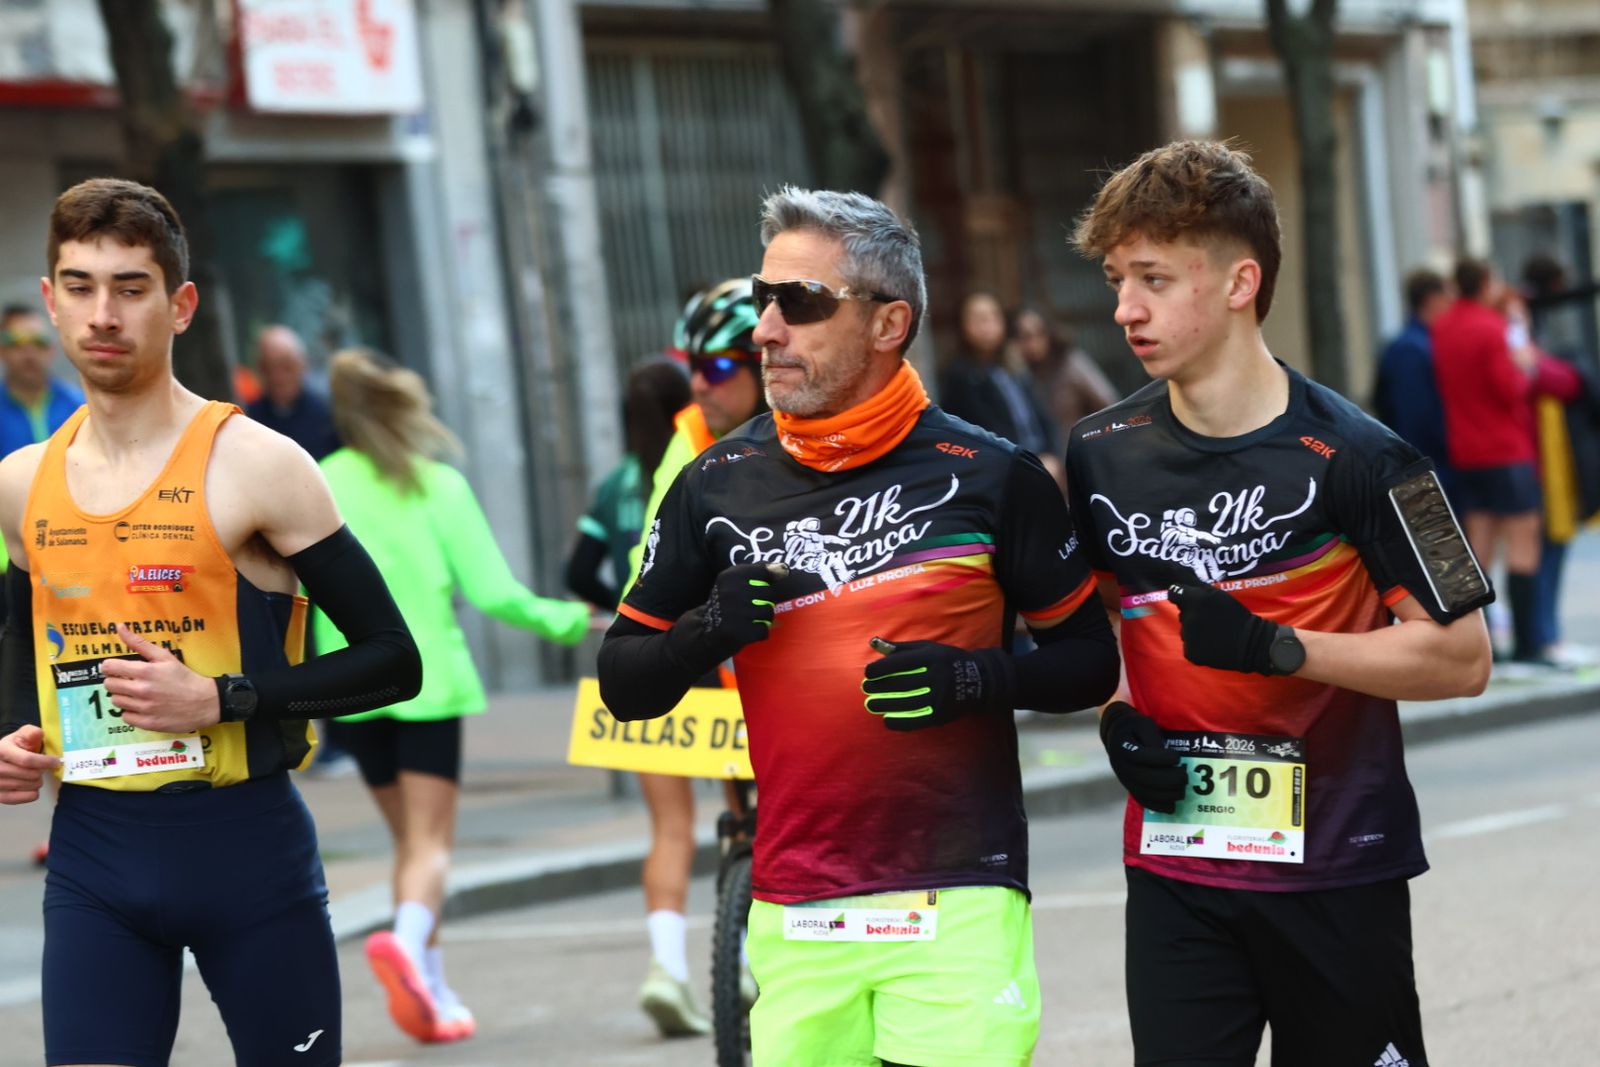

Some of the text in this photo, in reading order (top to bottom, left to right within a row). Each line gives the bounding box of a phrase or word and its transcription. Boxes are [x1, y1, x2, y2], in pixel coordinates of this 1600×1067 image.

[936, 442, 980, 460] 42K
[1299, 435, 1337, 459] 42K
[158, 486, 195, 503] EKT
[162, 533, 195, 541] DENTAL
[1090, 494, 1292, 566] Salamanca
[138, 568, 182, 580] A.ELICES
[796, 592, 825, 609] CON
[850, 575, 876, 592] LUZ
[878, 564, 926, 584] PROPIA
[1220, 573, 1288, 592] LUZ PROPIA
[62, 622, 118, 636] ESCUELA
[108, 725, 135, 734] DIEGO
[590, 707, 697, 748] SILLAS
[1225, 738, 1255, 751] 2026
[136, 753, 188, 768] bedunia
[1180, 763, 1272, 799] 310
[1197, 804, 1236, 814] SERGIO
[1149, 833, 1186, 844] LABORAL
[1226, 842, 1286, 856] bedunia
[791, 919, 829, 929] LABORAL
[866, 923, 921, 935] bedunia
